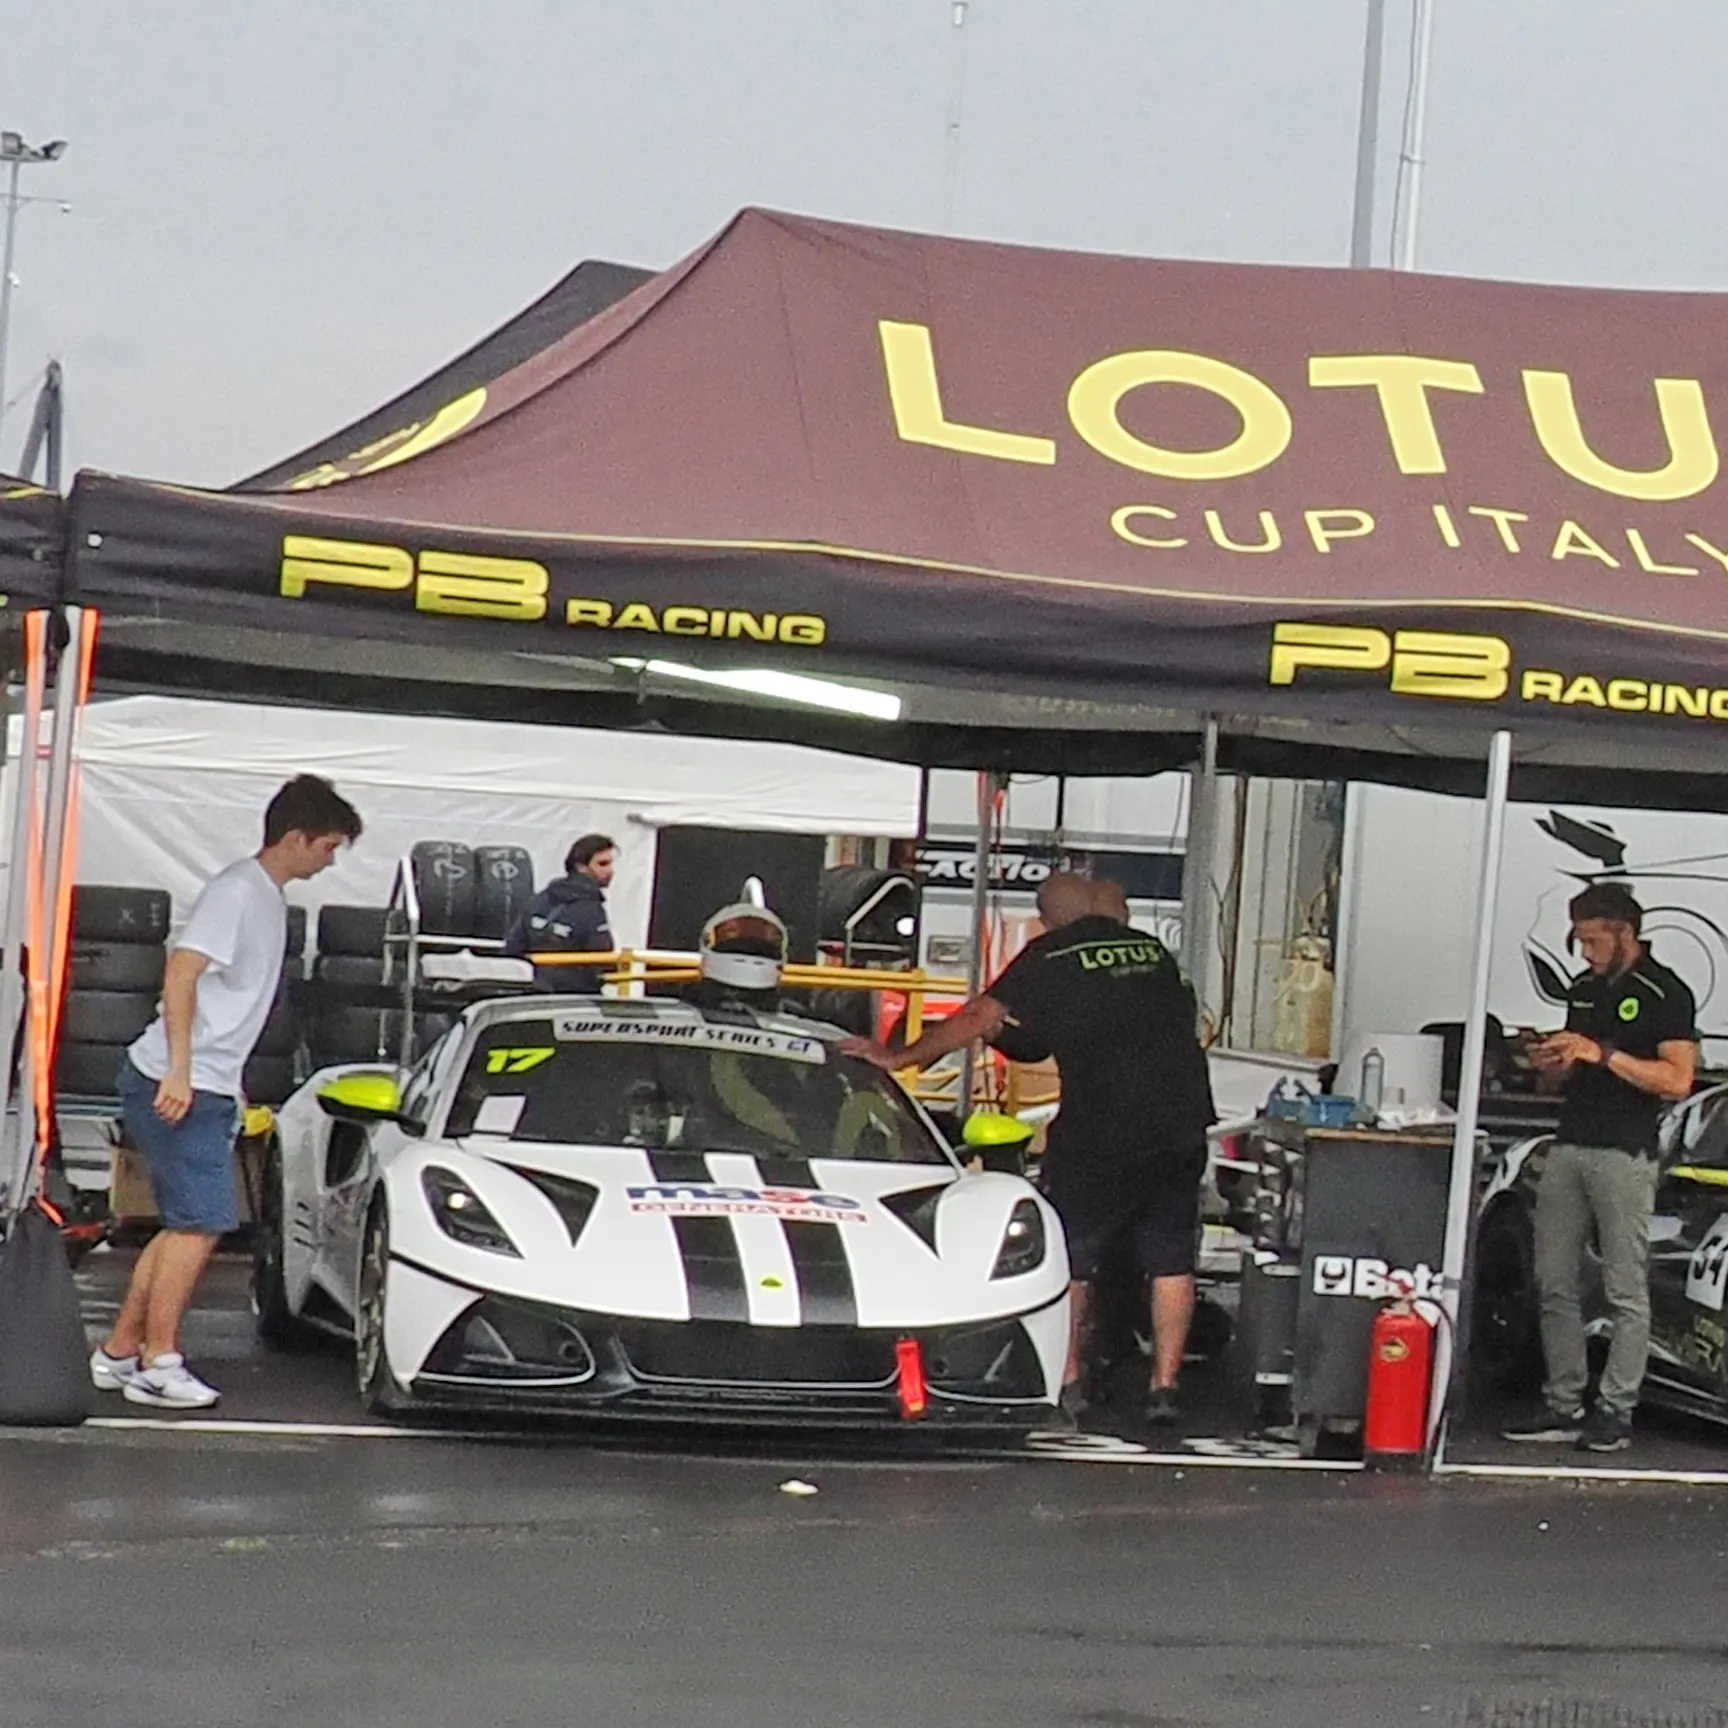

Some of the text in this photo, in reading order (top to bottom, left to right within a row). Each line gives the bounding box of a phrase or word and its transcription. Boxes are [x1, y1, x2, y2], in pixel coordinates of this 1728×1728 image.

[1109, 504, 1376, 555] CUP
[280, 534, 827, 646] PB RACING
[1269, 622, 1512, 700] PB
[1079, 945, 1160, 970] LOTUS
[486, 1047, 556, 1073] 17
